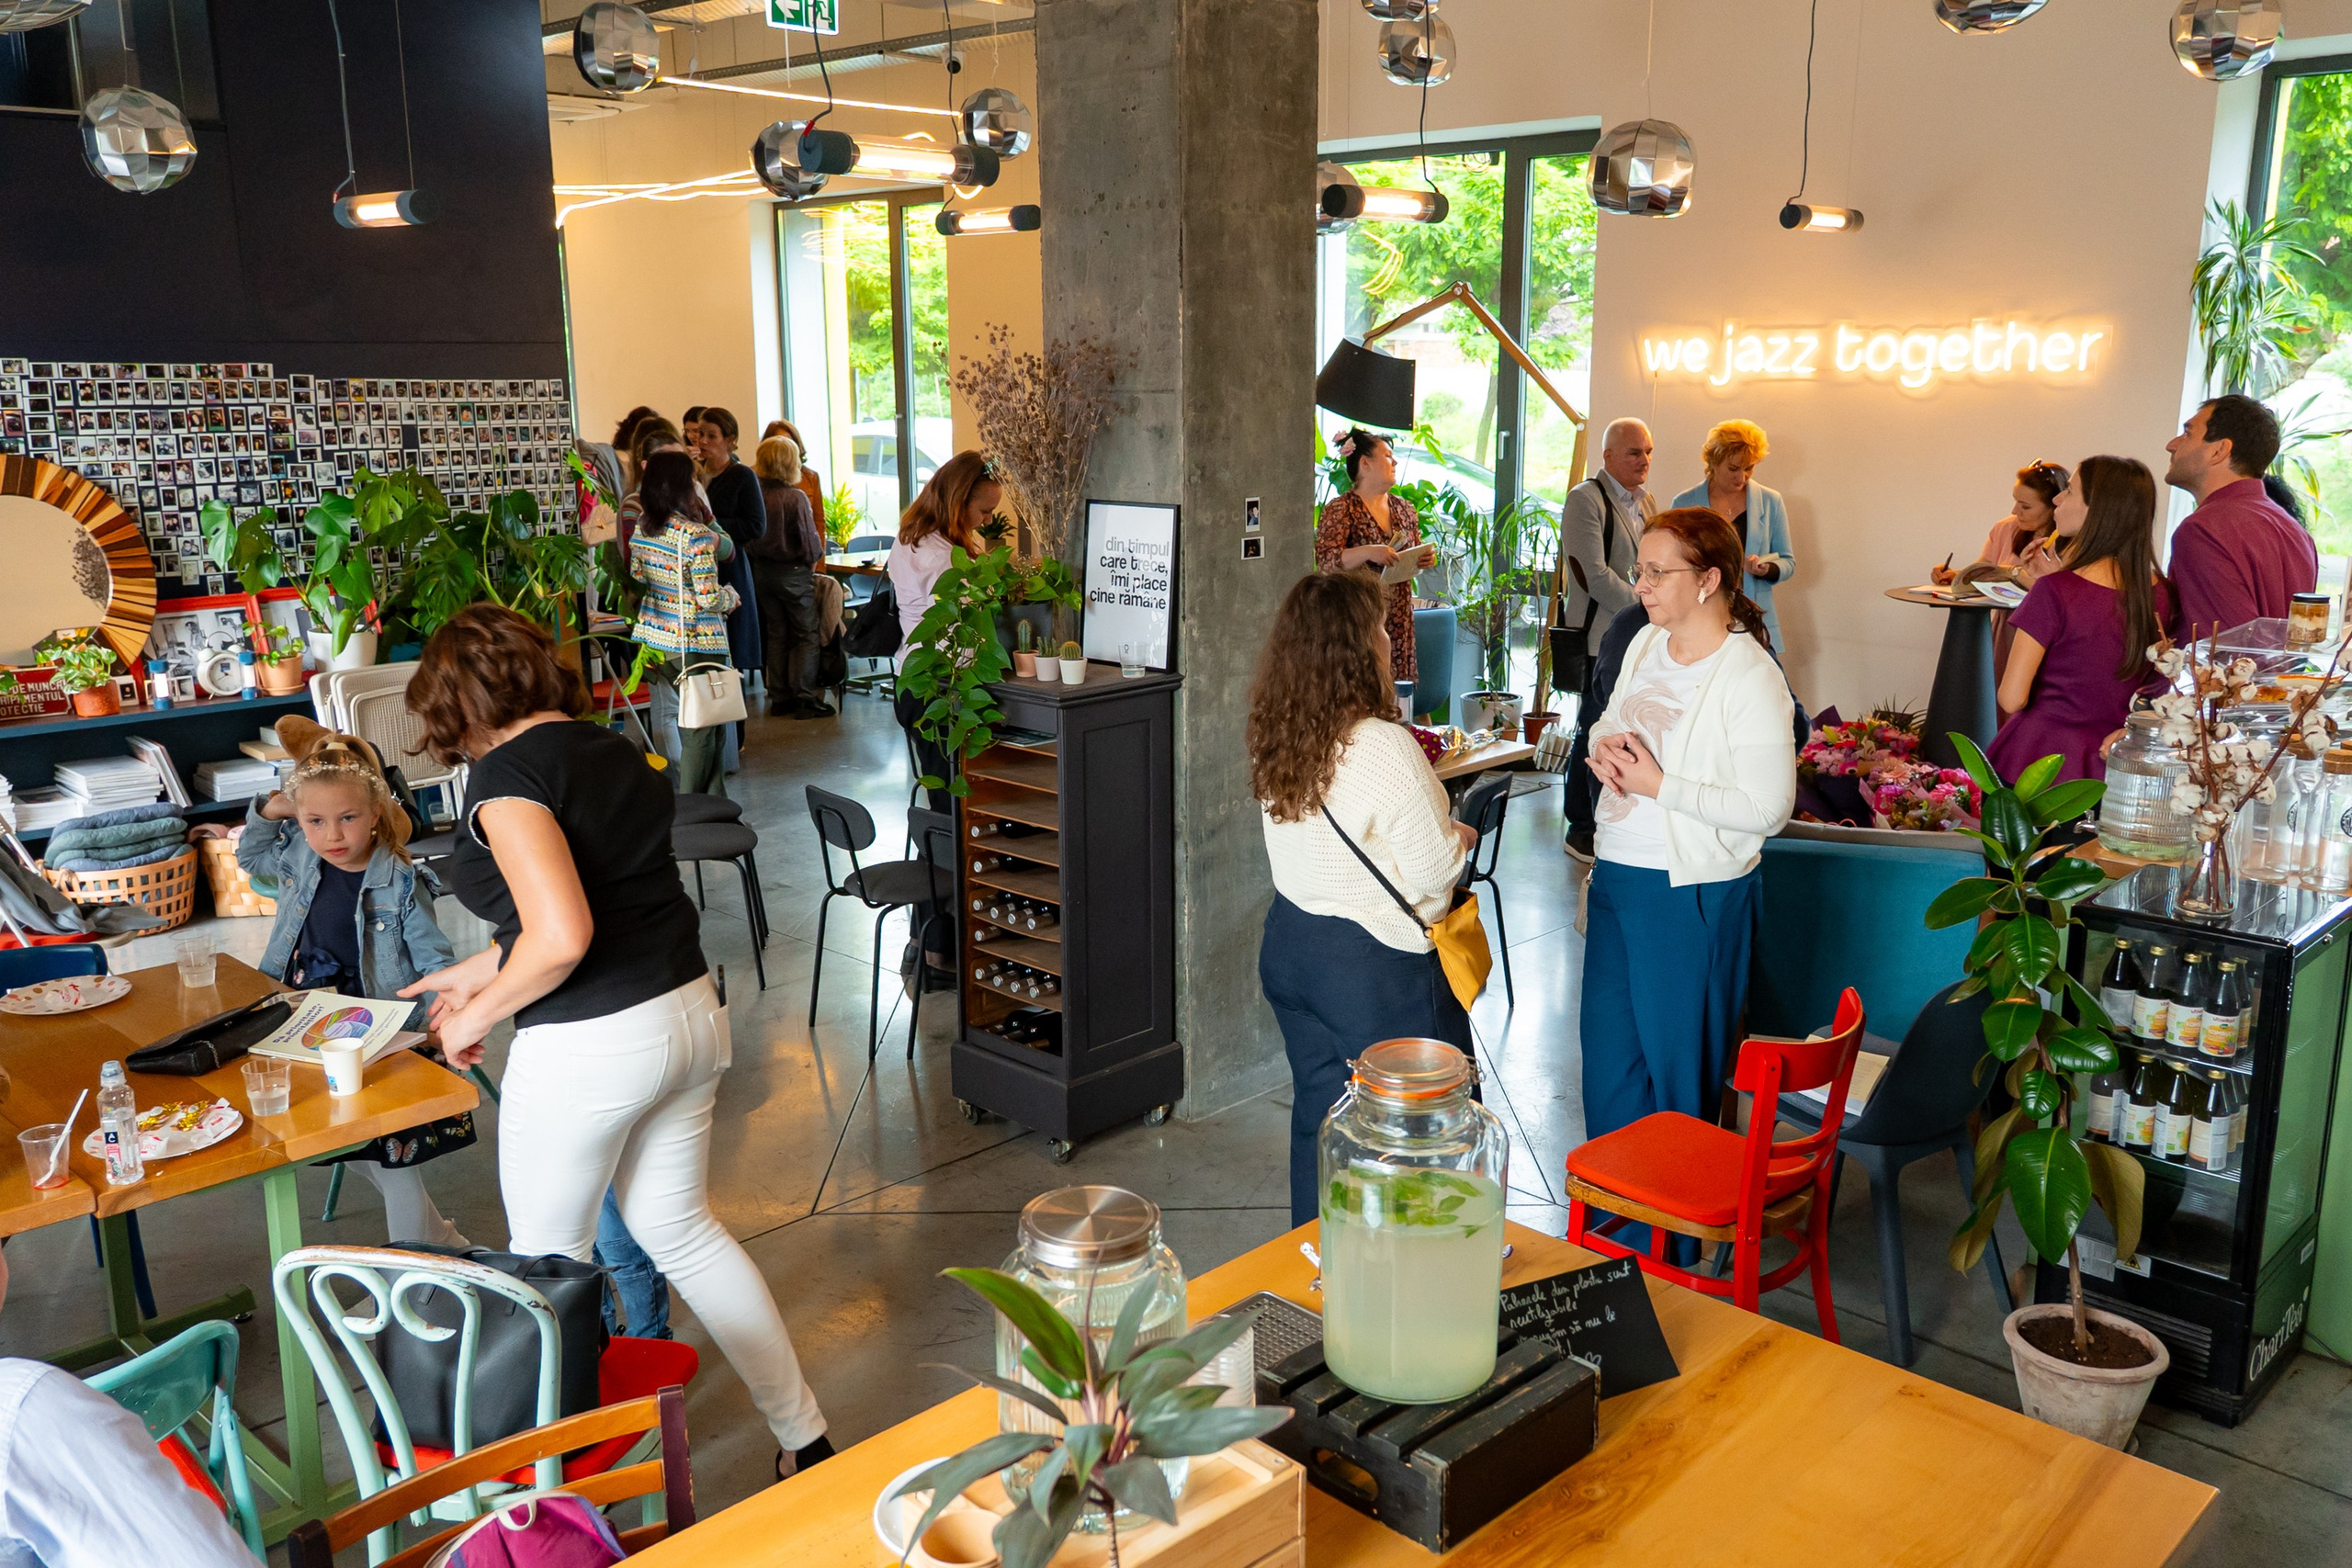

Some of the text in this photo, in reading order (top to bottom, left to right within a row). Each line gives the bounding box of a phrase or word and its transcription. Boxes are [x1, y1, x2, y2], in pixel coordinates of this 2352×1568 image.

[1643, 320, 2105, 389] we jazz together
[1105, 536, 1170, 560] din timpul
[1100, 555, 1169, 576] care trece,
[1110, 569, 1168, 593] îmi place
[1090, 587, 1167, 610] cine rămâne
[1551, 1280, 1570, 1298] din
[1607, 1260, 1633, 1283] sunt
[1569, 1320, 1583, 1335] să
[1585, 1318, 1602, 1329] nu
[2249, 1303, 2303, 1382] ChariTea
